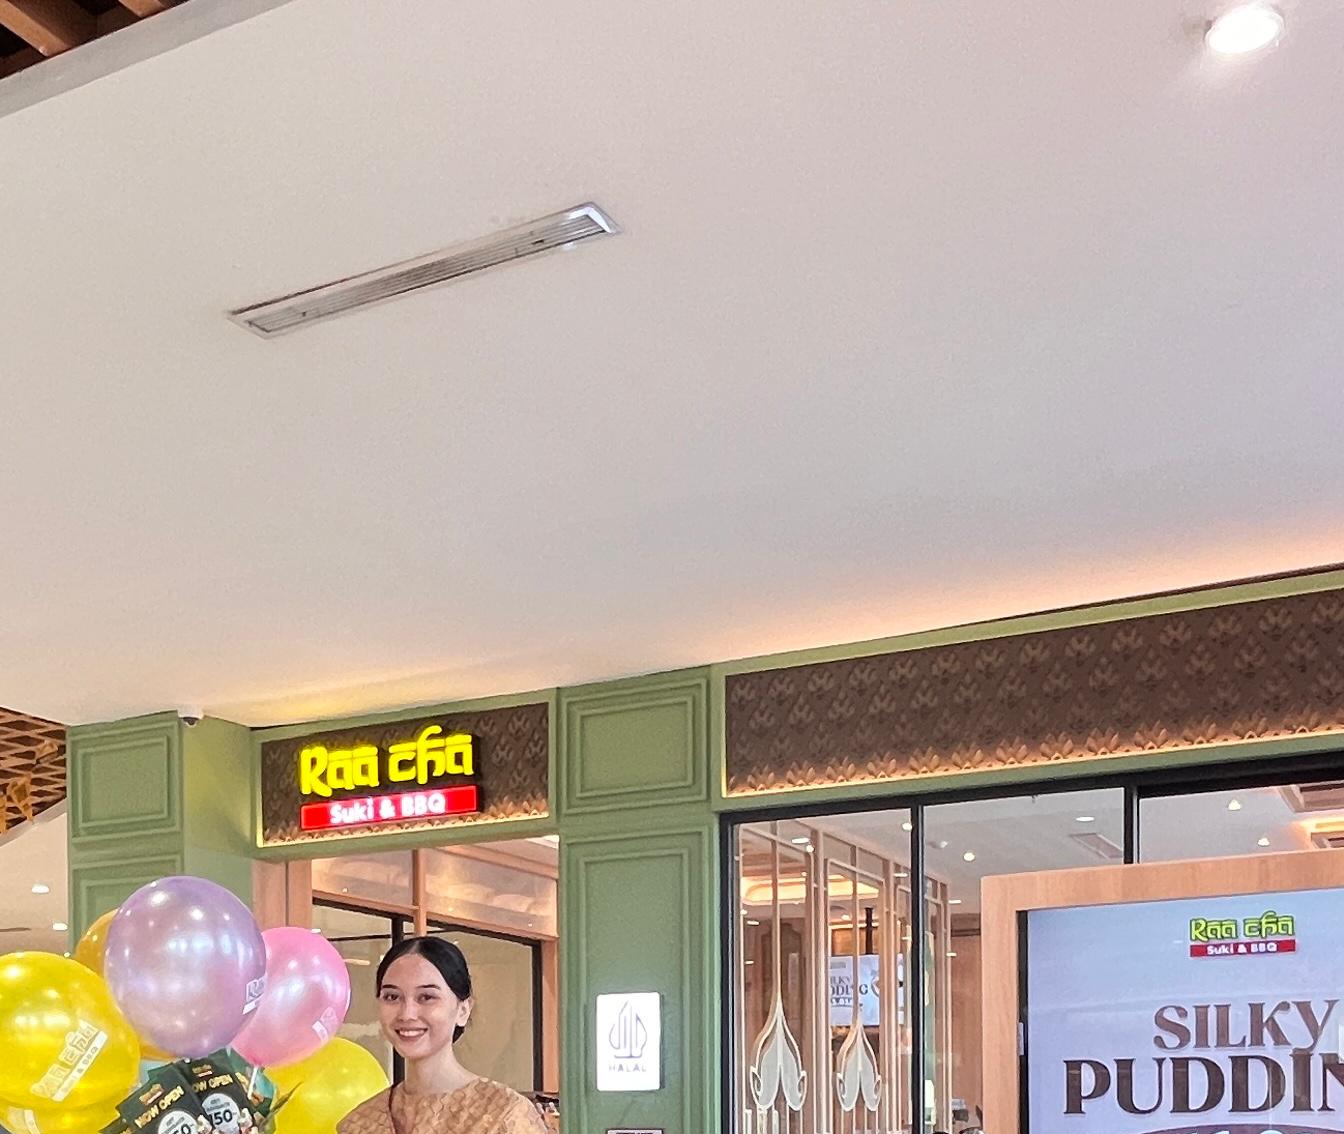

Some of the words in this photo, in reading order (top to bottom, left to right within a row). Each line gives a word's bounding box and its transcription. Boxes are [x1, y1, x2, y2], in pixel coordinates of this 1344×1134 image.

[329, 797, 374, 824] Suki
[379, 798, 395, 819] &
[401, 793, 446, 816] BBQ
[1153, 1000, 1340, 1053] SILKY
[608, 1063, 647, 1072] HALAL
[159, 1086, 185, 1110] OPEN
[192, 1080, 208, 1092] OW
